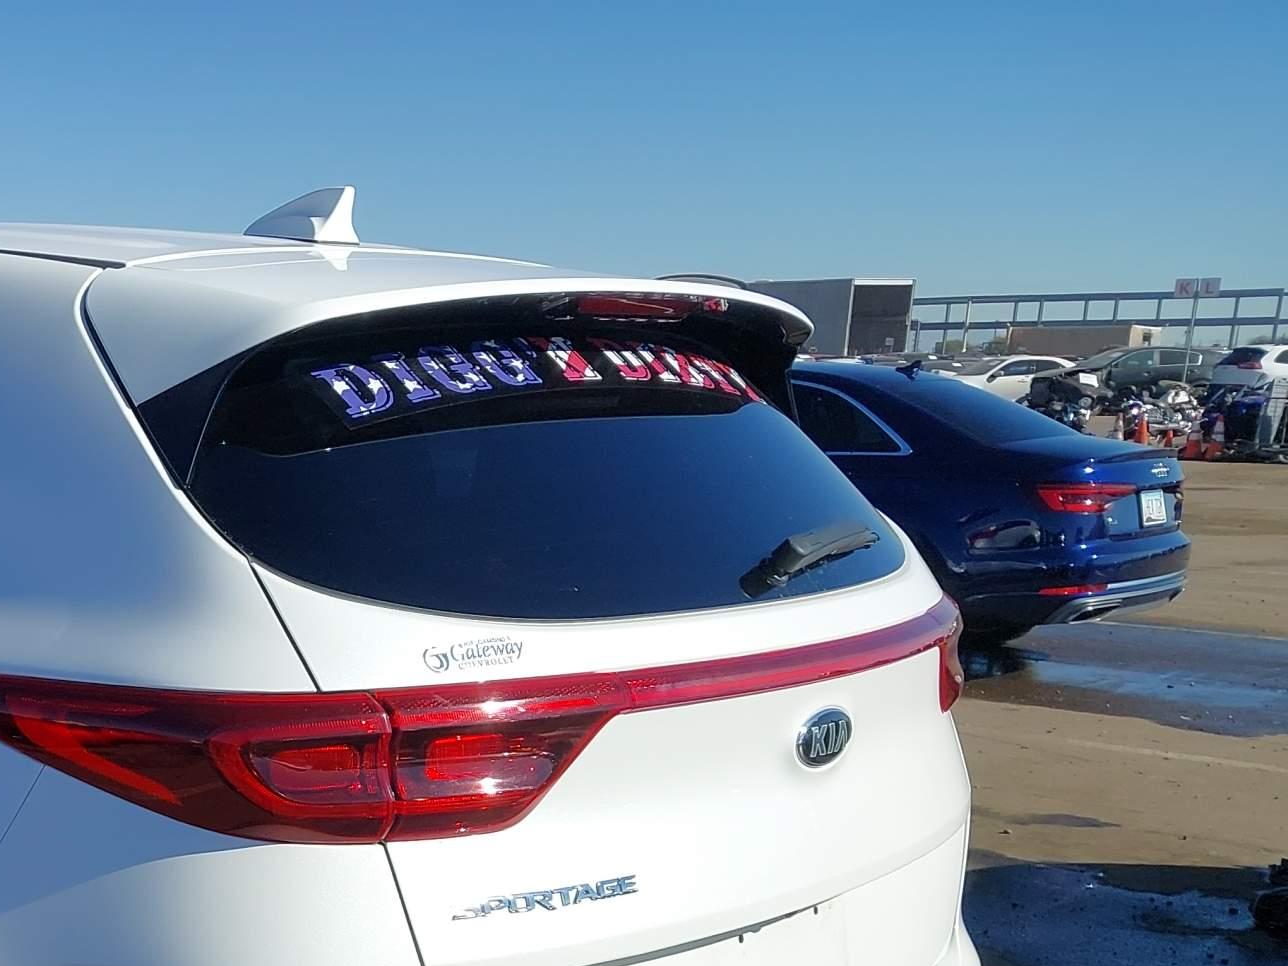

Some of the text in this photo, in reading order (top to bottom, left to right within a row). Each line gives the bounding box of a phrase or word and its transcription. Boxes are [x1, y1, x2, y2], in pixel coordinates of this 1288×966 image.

[1179, 282, 1191, 295] K
[1205, 282, 1214, 294] L
[450, 641, 523, 662] Gateway
[809, 720, 848, 758] KIA
[452, 874, 639, 921] SPORTAGE
